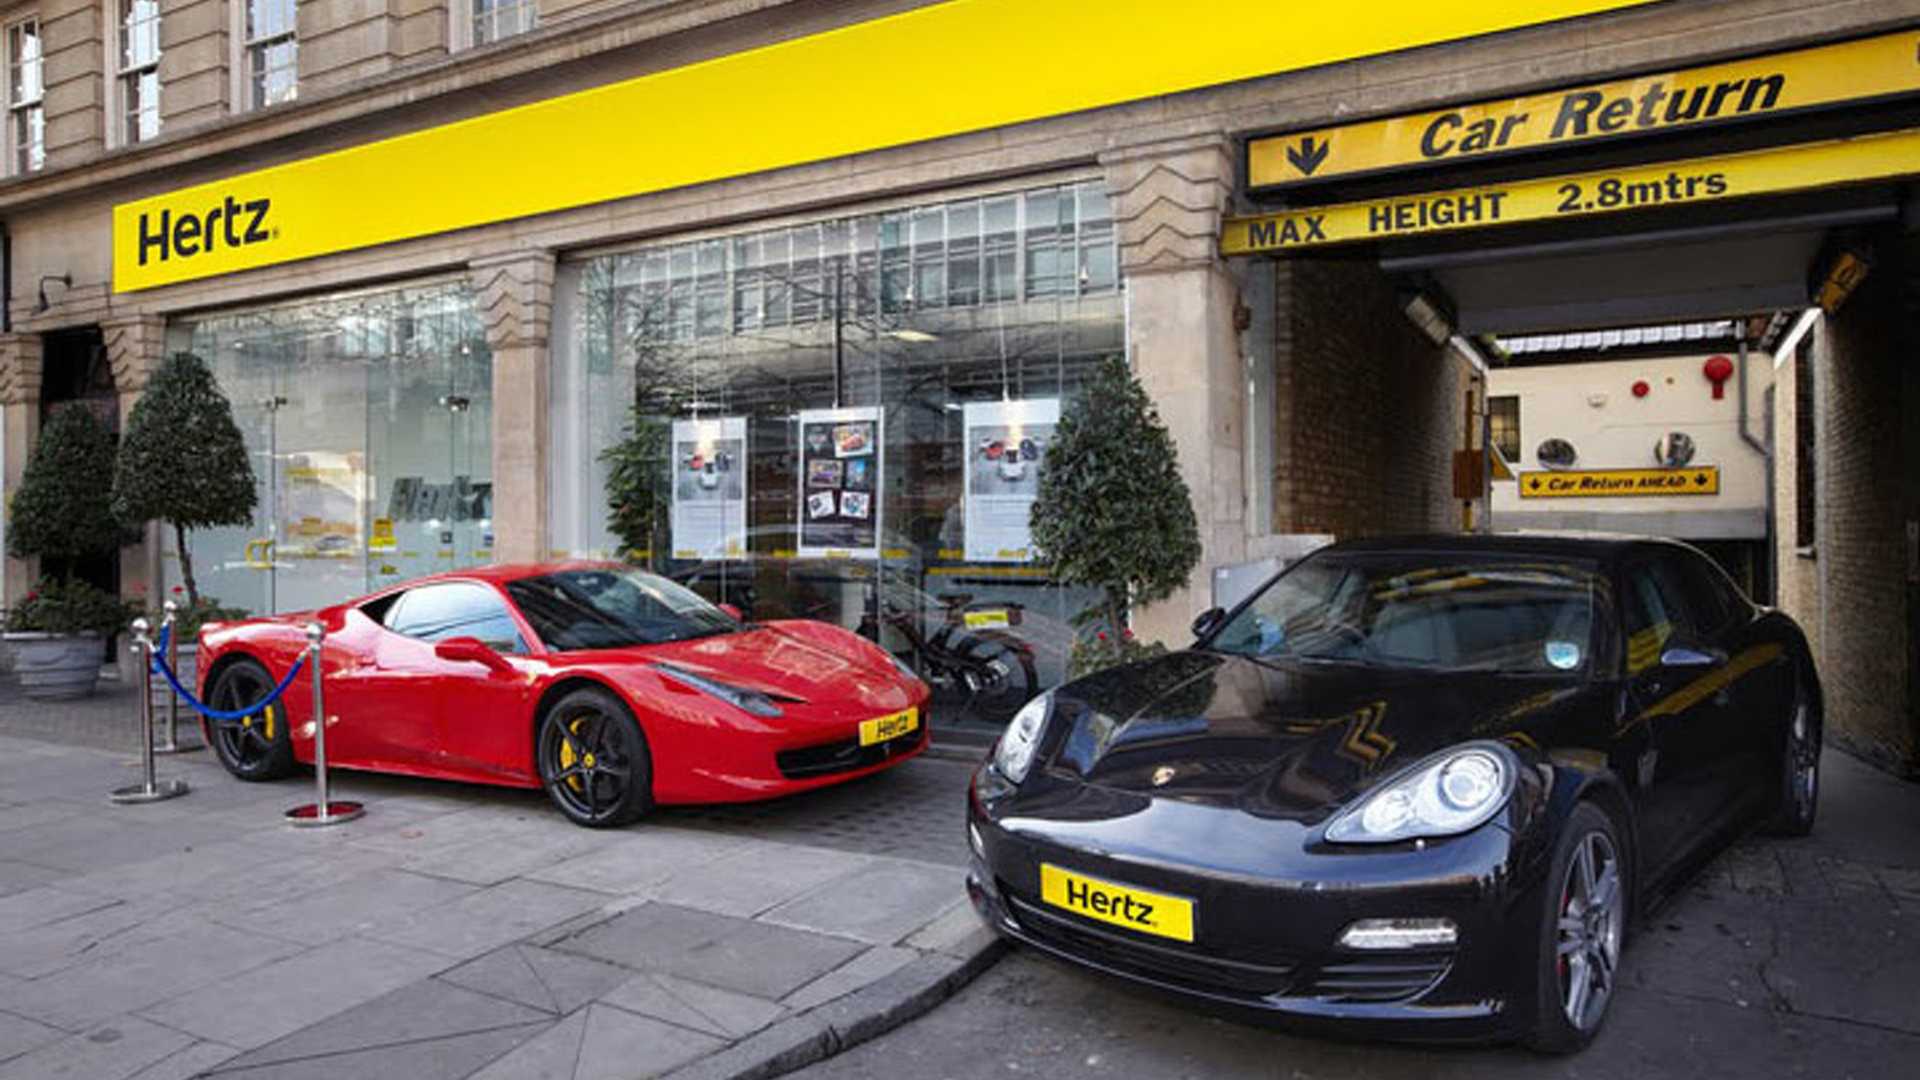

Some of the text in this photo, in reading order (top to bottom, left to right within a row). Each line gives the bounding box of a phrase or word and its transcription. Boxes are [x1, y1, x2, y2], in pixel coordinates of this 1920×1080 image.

[1420, 72, 1786, 157] Car Return
[138, 195, 271, 267] Hertz
[1249, 171, 1728, 248] MAX HEIGHT 2.8mtrs
[1548, 474, 1688, 491] Car Return AHEAD
[1066, 878, 1154, 925] Hertz
